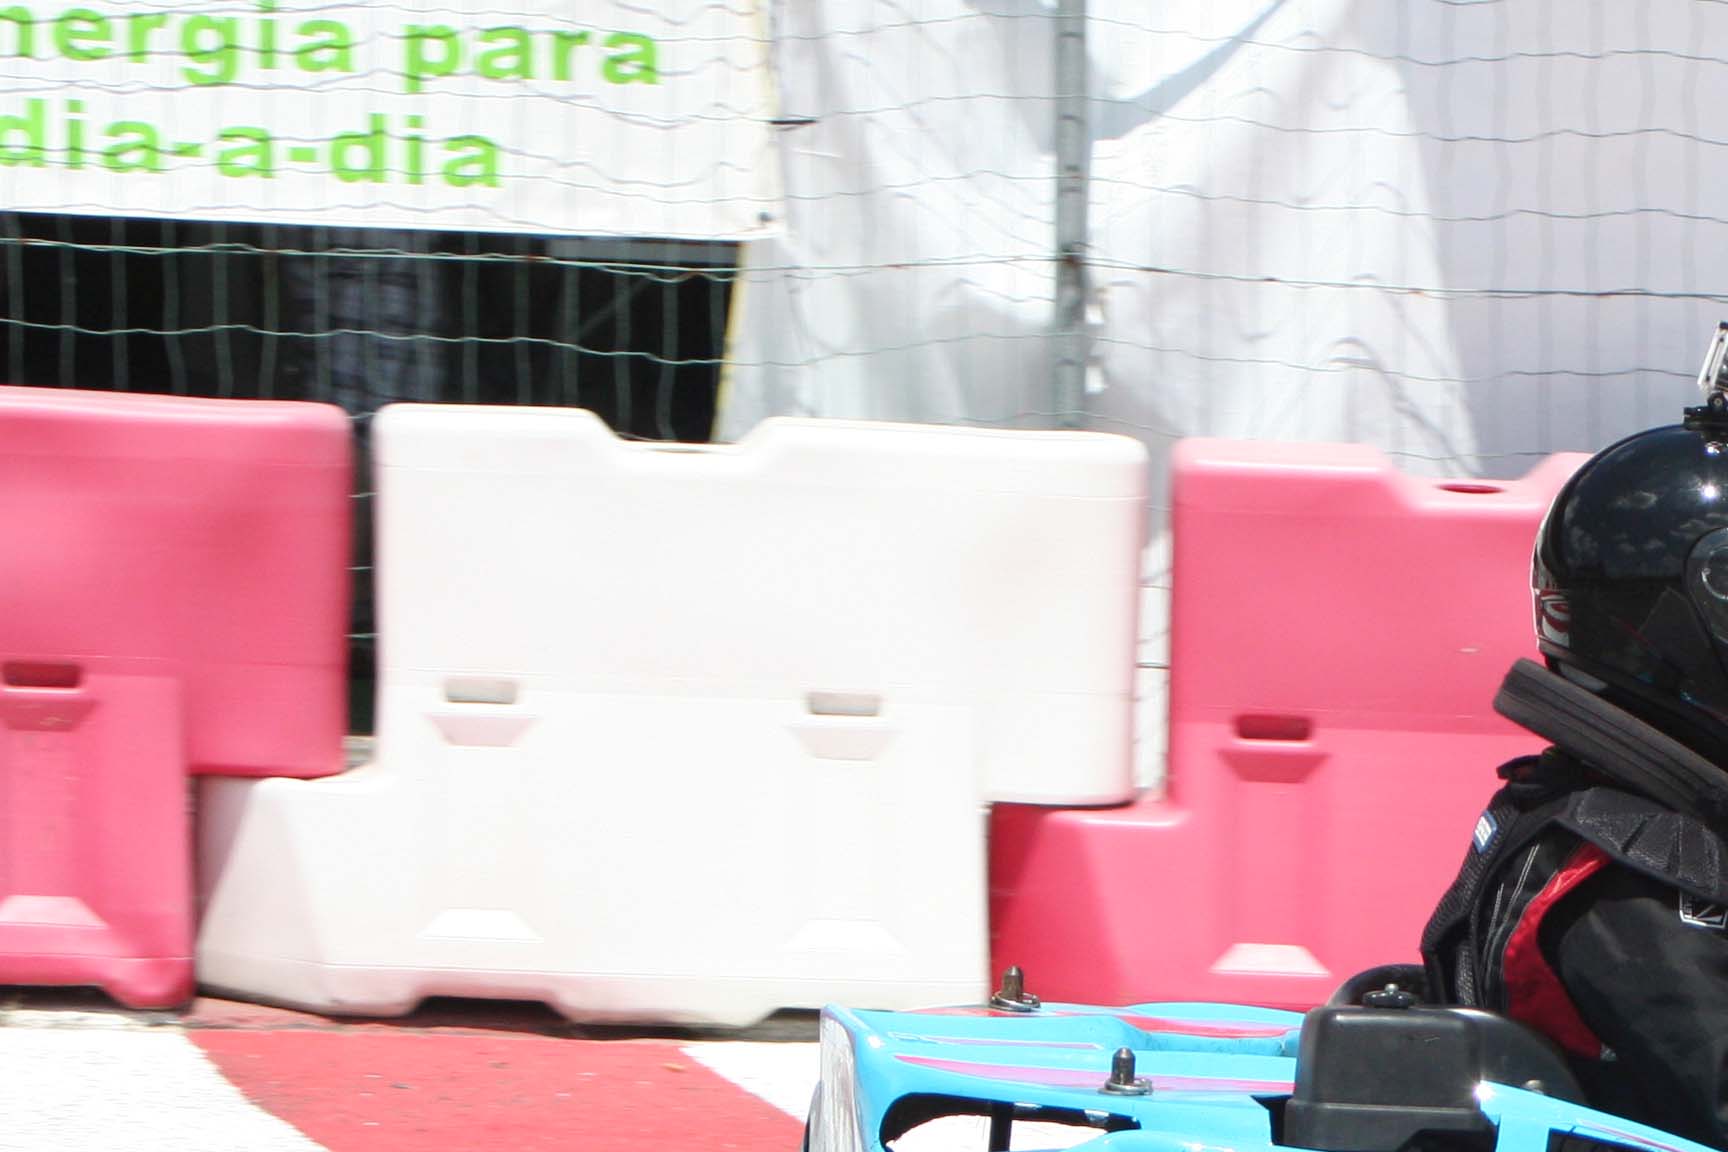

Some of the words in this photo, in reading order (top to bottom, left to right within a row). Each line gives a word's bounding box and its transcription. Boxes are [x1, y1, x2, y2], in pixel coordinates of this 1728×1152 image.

[0, 0, 356, 85] nergia
[402, 24, 662, 94] para
[0, 97, 502, 188] dia-a-dia
